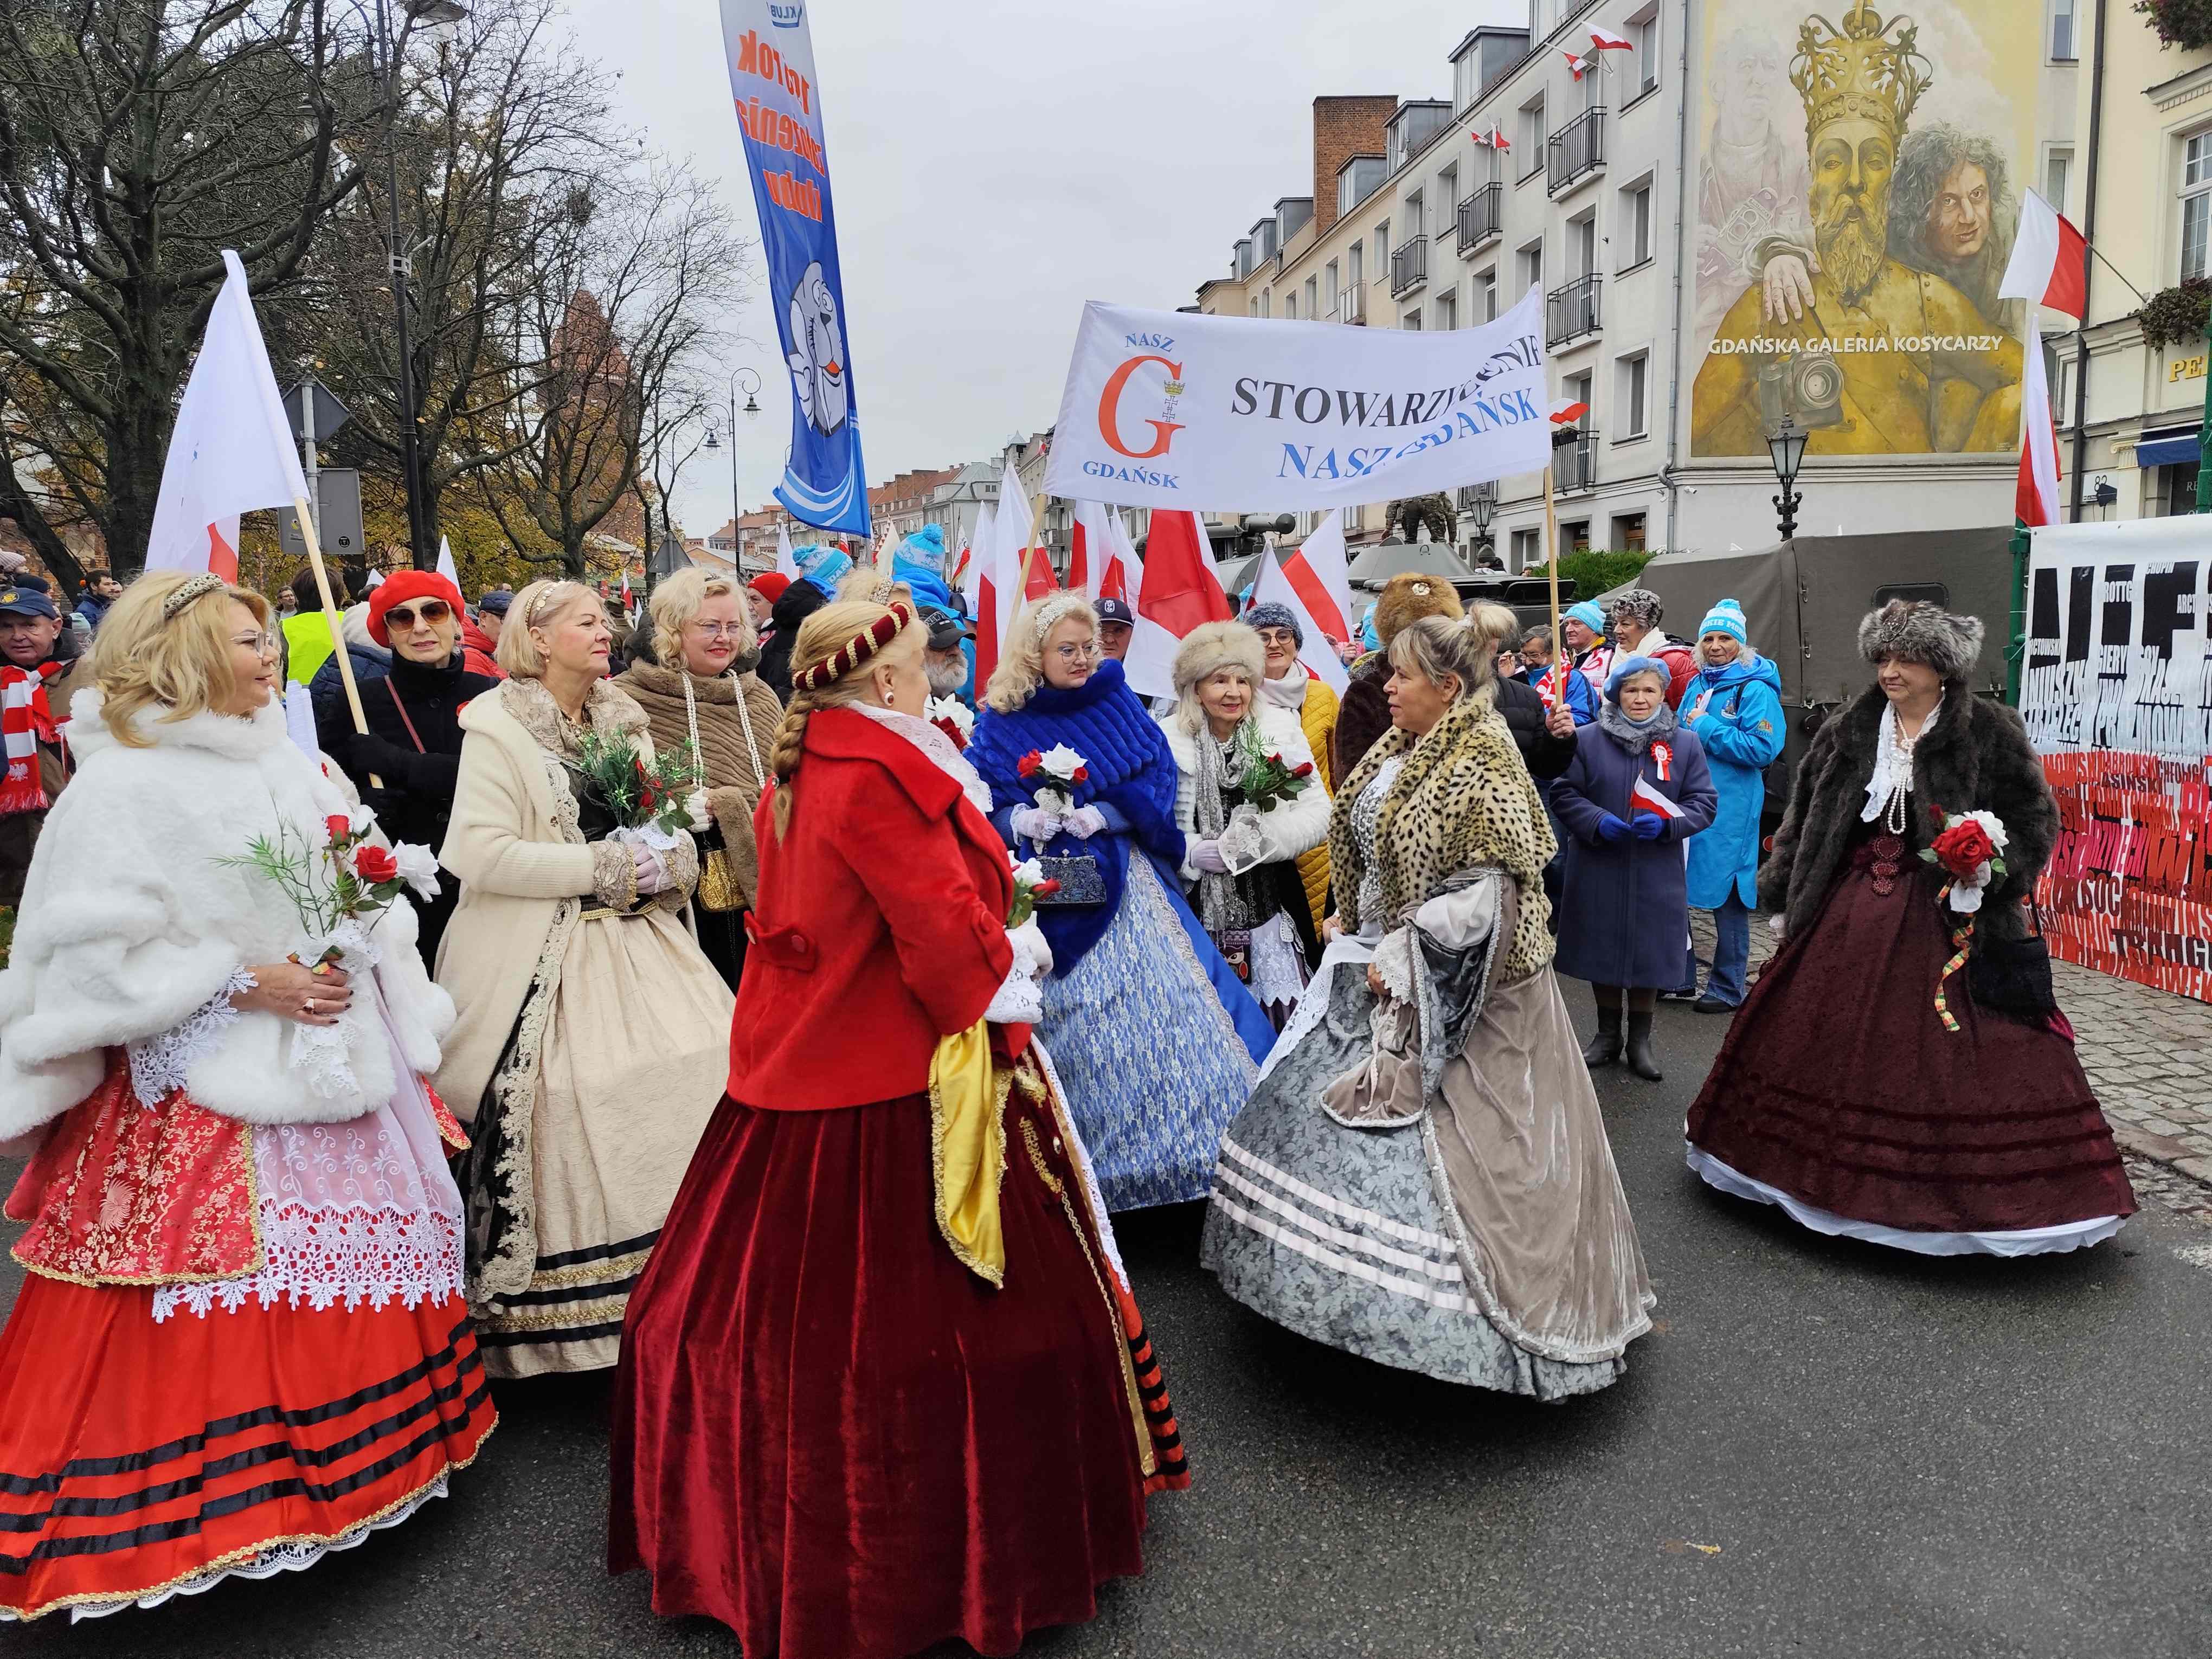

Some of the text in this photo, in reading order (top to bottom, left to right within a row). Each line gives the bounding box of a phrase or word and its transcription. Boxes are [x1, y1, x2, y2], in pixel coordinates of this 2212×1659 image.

[1124, 332, 1175, 352] NASZ
[1708, 334, 2004, 354] GDAŃSKA GALERIA KOSYCARZY
[1083, 460, 1180, 490] GDAŃSK
[2029, 638, 2061, 656] RCTOWSK
